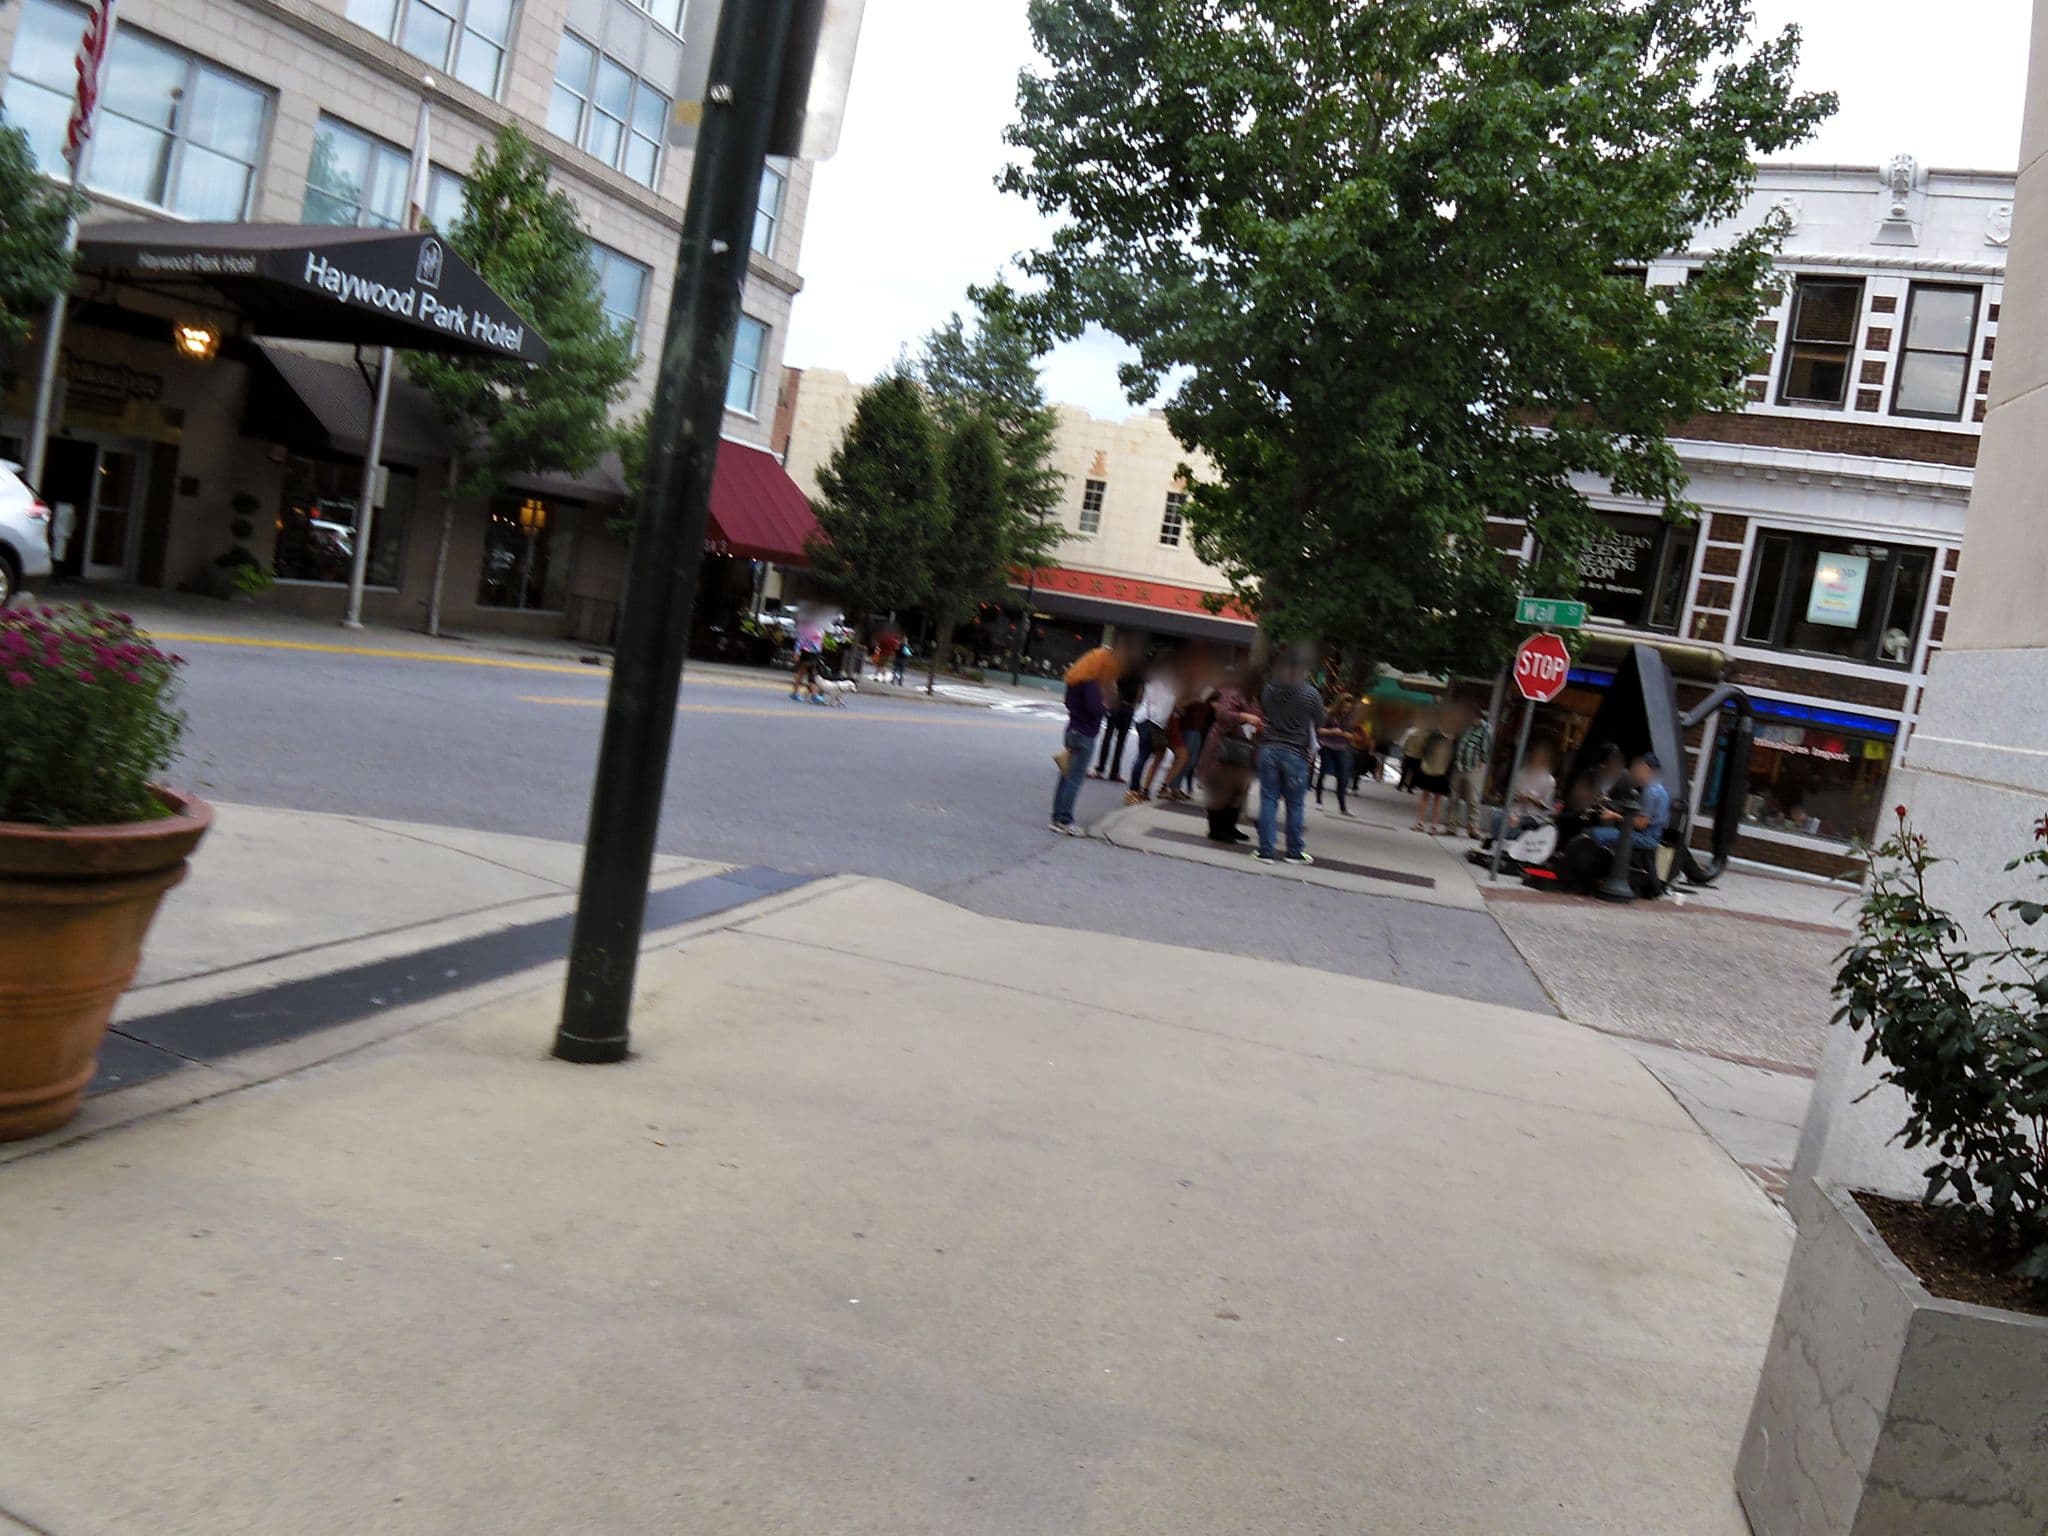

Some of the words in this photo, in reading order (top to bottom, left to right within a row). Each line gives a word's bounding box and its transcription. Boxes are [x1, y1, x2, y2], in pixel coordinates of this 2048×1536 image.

[138, 252, 192, 273] Haywood
[193, 253, 221, 272] Park
[222, 254, 257, 273] Hotel
[304, 250, 416, 317] Haywood
[418, 291, 469, 336] Park
[470, 310, 525, 352] Hotel
[1523, 601, 1557, 622] Wall
[1518, 650, 1565, 682] STOP
